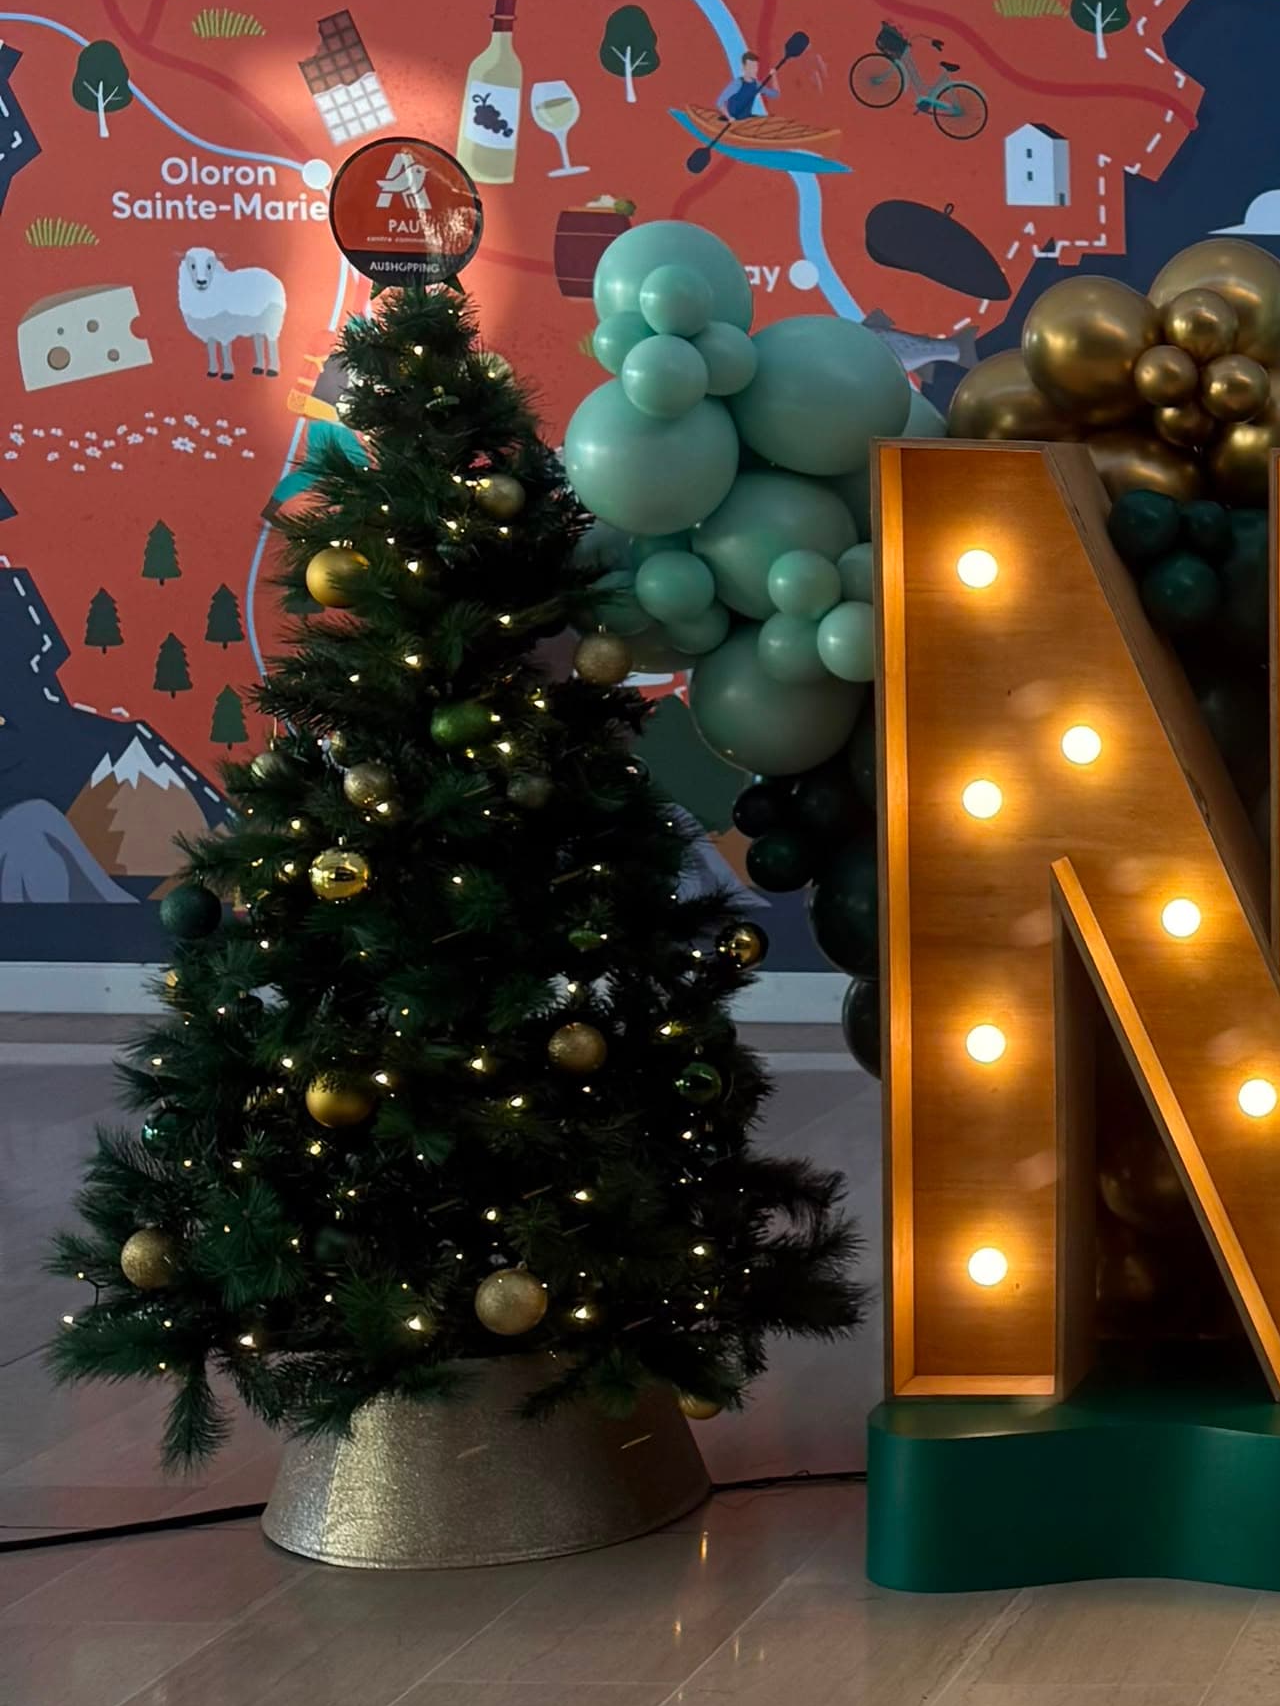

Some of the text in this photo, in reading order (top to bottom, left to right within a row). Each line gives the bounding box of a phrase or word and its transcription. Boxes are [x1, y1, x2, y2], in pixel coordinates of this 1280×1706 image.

[161, 156, 276, 186] Oloron
[112, 191, 328, 221] Sainte-Marie
[388, 218, 420, 234] PAU
[369, 260, 441, 274] AUSHOPPING
[743, 265, 781, 292] ay
